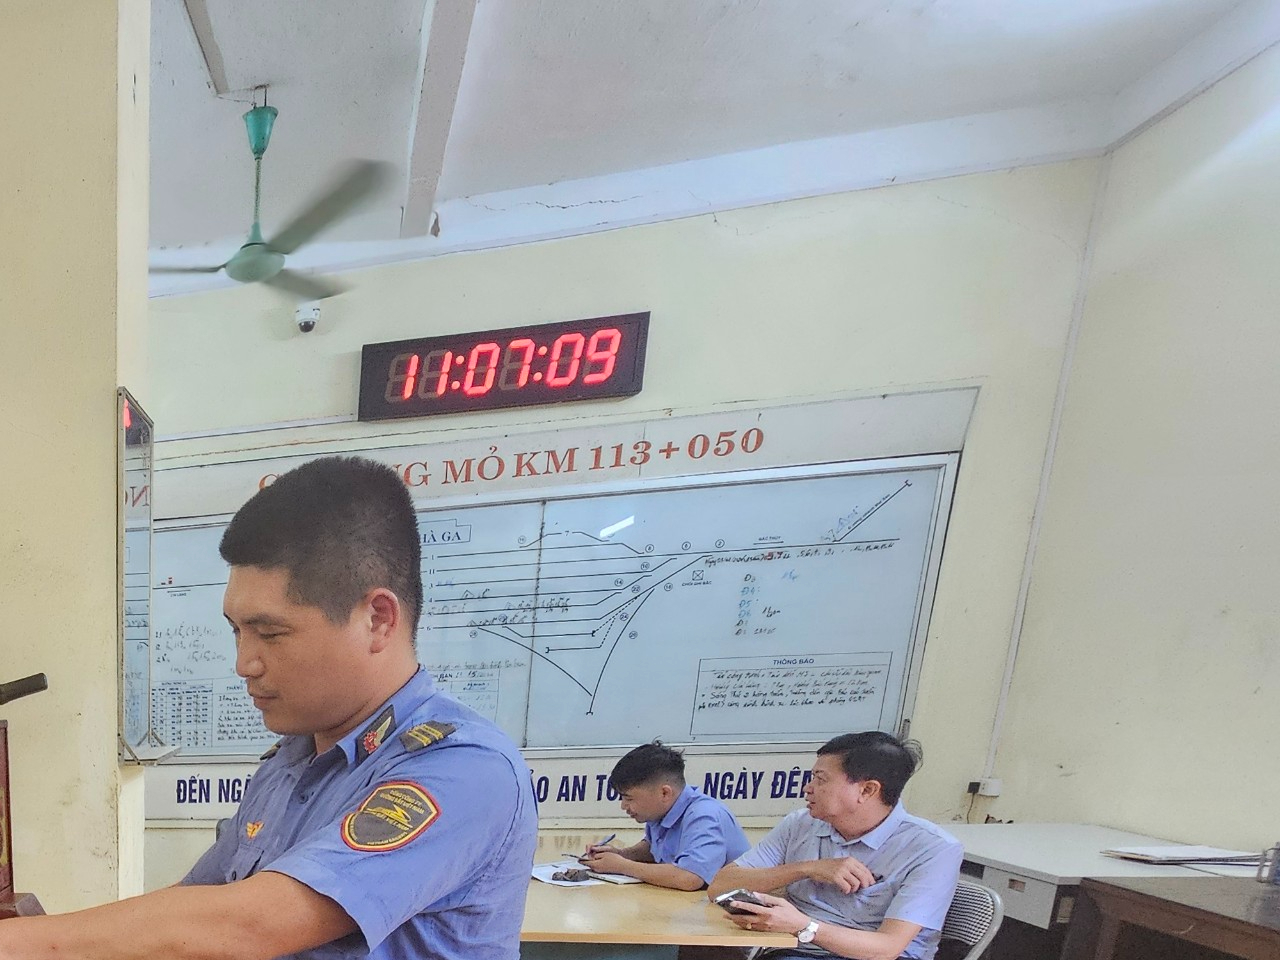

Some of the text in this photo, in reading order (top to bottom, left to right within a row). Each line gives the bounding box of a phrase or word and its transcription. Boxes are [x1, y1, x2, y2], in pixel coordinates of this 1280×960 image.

[402, 328, 622, 400] 11:07:09
[441, 446, 505, 485] MỎ
[511, 447, 579, 478] KM
[588, 427, 764, 470] 113+050
[441, 531, 461, 542] GA
[773, 658, 798, 666] THÔNG
[176, 773, 210, 803] ĐẾN
[556, 775, 587, 802] AN
[703, 766, 764, 800] NGÀY
